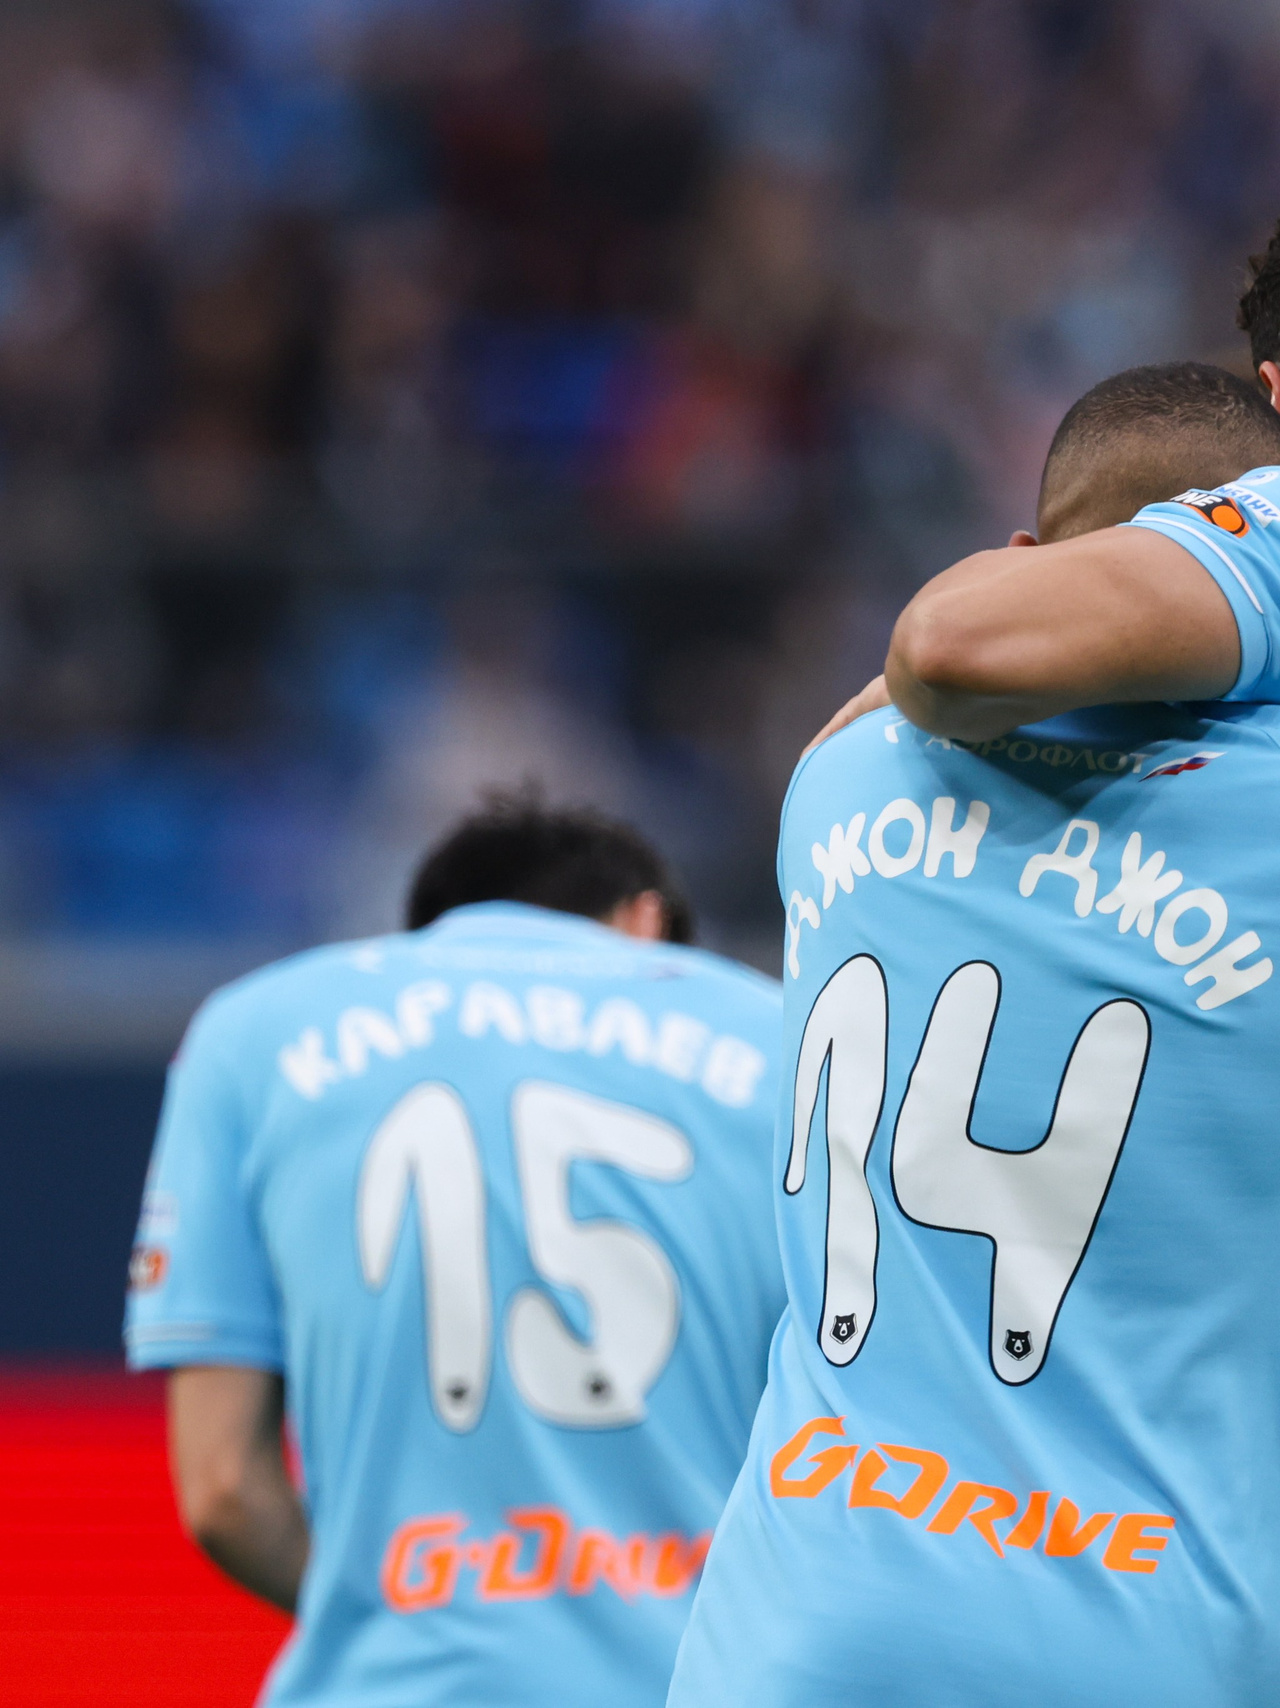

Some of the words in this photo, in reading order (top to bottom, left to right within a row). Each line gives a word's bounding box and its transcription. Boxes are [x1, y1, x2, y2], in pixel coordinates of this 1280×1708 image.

[925, 731, 1152, 775] АРОФЛОТ
[786, 796, 991, 981] ДЖОН
[1018, 818, 1274, 1012] ДЖОН
[356, 1077, 696, 1436] 15
[782, 952, 1153, 1388] 14
